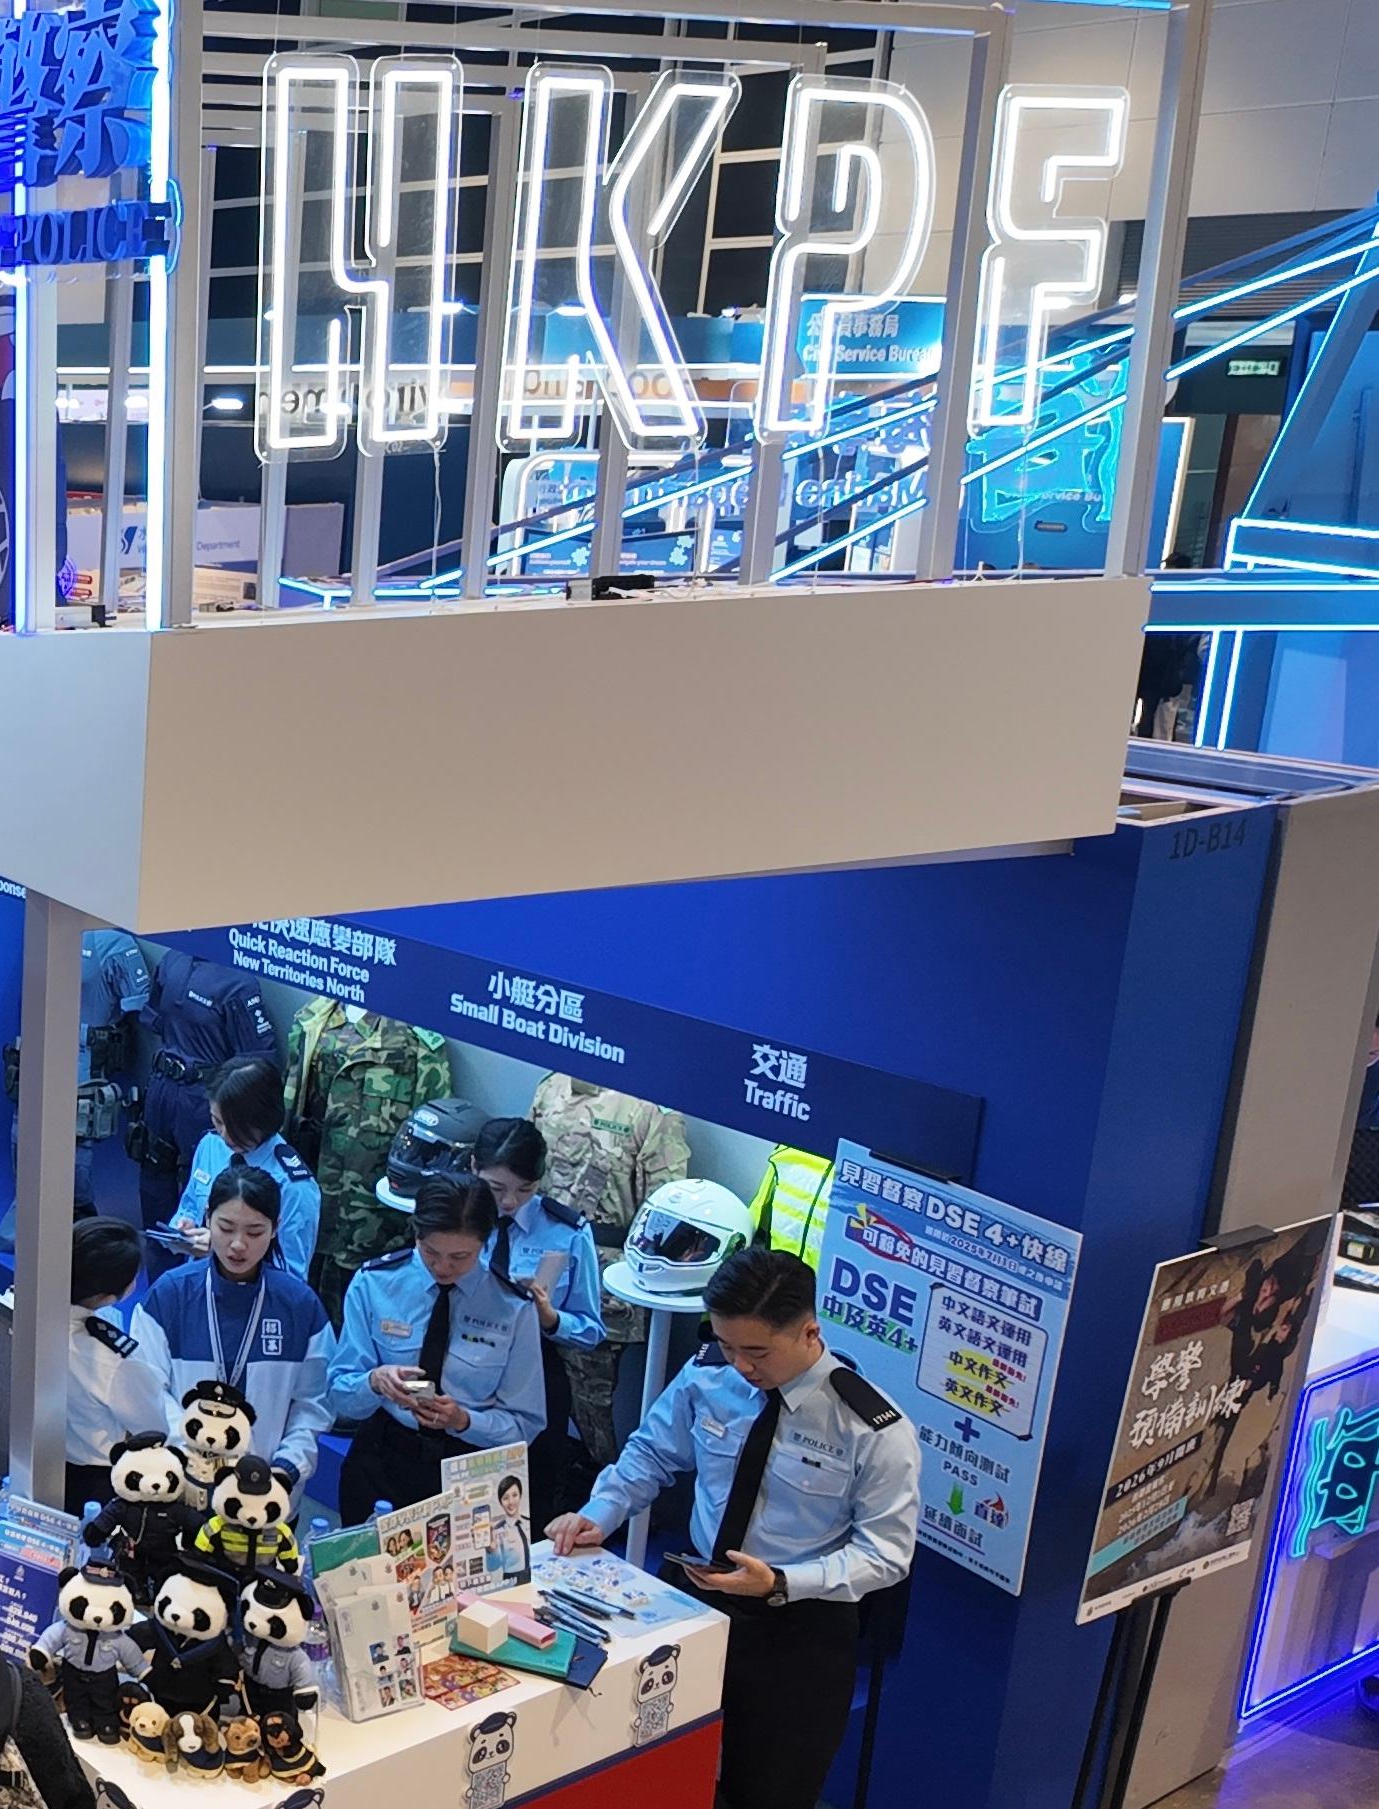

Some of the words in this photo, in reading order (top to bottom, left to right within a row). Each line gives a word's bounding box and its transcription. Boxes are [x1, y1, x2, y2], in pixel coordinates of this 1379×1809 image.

[19, 202, 148, 265] POLICE
[266, 65, 1128, 450] HKPF
[806, 312, 900, 338] 公員事務局
[836, 344, 886, 362] Service
[1168, 818, 1248, 860] 1D-B14
[228, 928, 267, 954] Quick
[268, 938, 329, 973] Reaction
[330, 956, 370, 984] Force
[233, 949, 261, 972] New
[262, 957, 325, 991] Territories
[326, 976, 365, 1003] North
[487, 970, 585, 1024] 小艇分區
[449, 993, 499, 1026] Small
[501, 1010, 546, 1041] Boat
[548, 1023, 626, 1065] Division
[750, 1043, 808, 1089] 交通
[743, 1078, 812, 1123] Traffic
[840, 1159, 924, 1214] 見習督察
[926, 1196, 983, 1239] DSE
[983, 1221, 1071, 1275] 4+快線
[830, 1256, 918, 1328] DSE
[822, 1295, 919, 1354] 中及英4+
[938, 1315, 1028, 1368] 英文語文運用
[942, 1295, 1032, 1347] 中文語文運用
[948, 1350, 1009, 1390] 中文作文
[944, 1377, 1004, 1417] 英文作文
[803, 1436, 834, 1453] POLICE
[943, 1460, 979, 1486] PASS
